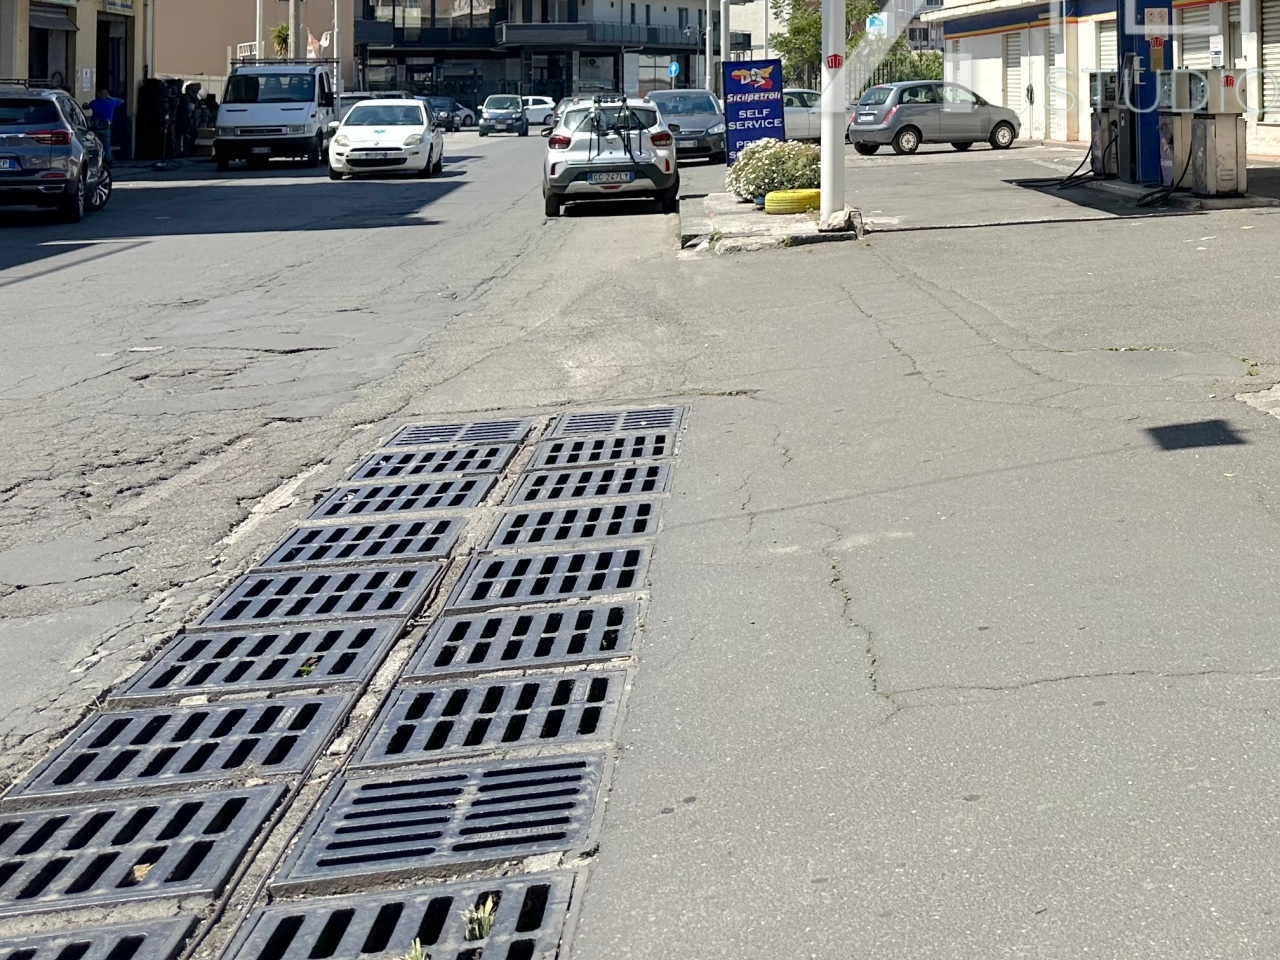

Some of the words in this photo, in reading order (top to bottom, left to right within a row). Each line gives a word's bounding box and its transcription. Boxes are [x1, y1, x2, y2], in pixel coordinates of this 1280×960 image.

[727, 91, 781, 102] Sicilpetroli
[738, 108, 771, 118] SELF
[728, 118, 783, 130] SERVICE
